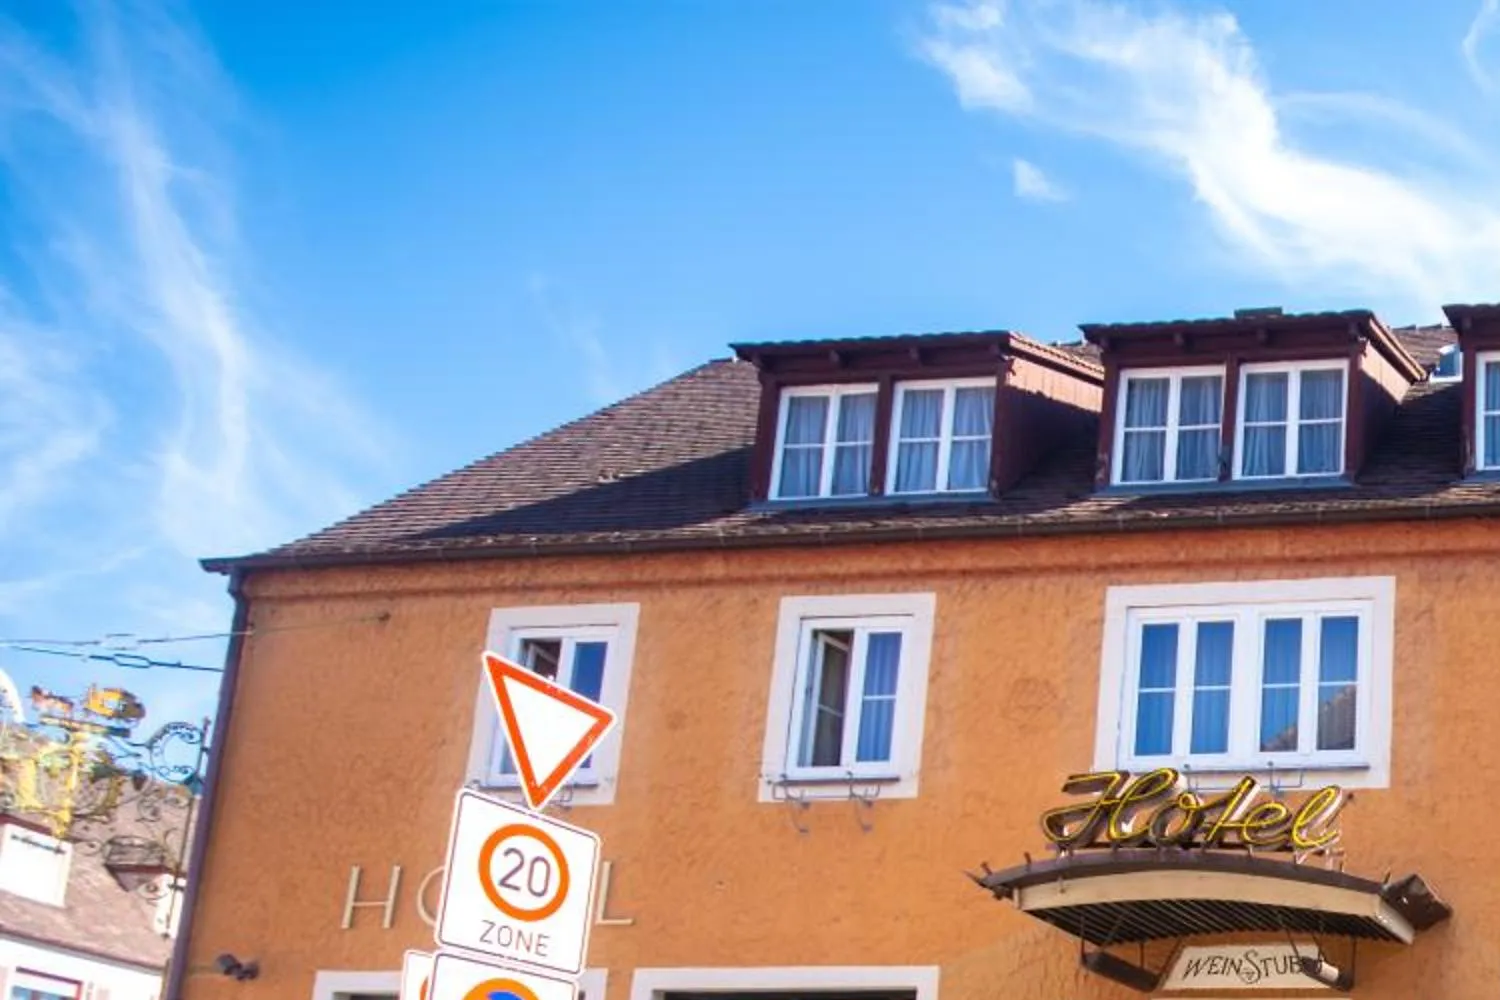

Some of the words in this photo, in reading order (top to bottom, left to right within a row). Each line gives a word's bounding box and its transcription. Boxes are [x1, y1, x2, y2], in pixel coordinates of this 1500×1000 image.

[1041, 767, 1343, 848] Hotel
[497, 846, 552, 898] 20
[478, 918, 551, 957] ZONE
[1182, 949, 1318, 985] WEINSTUB
